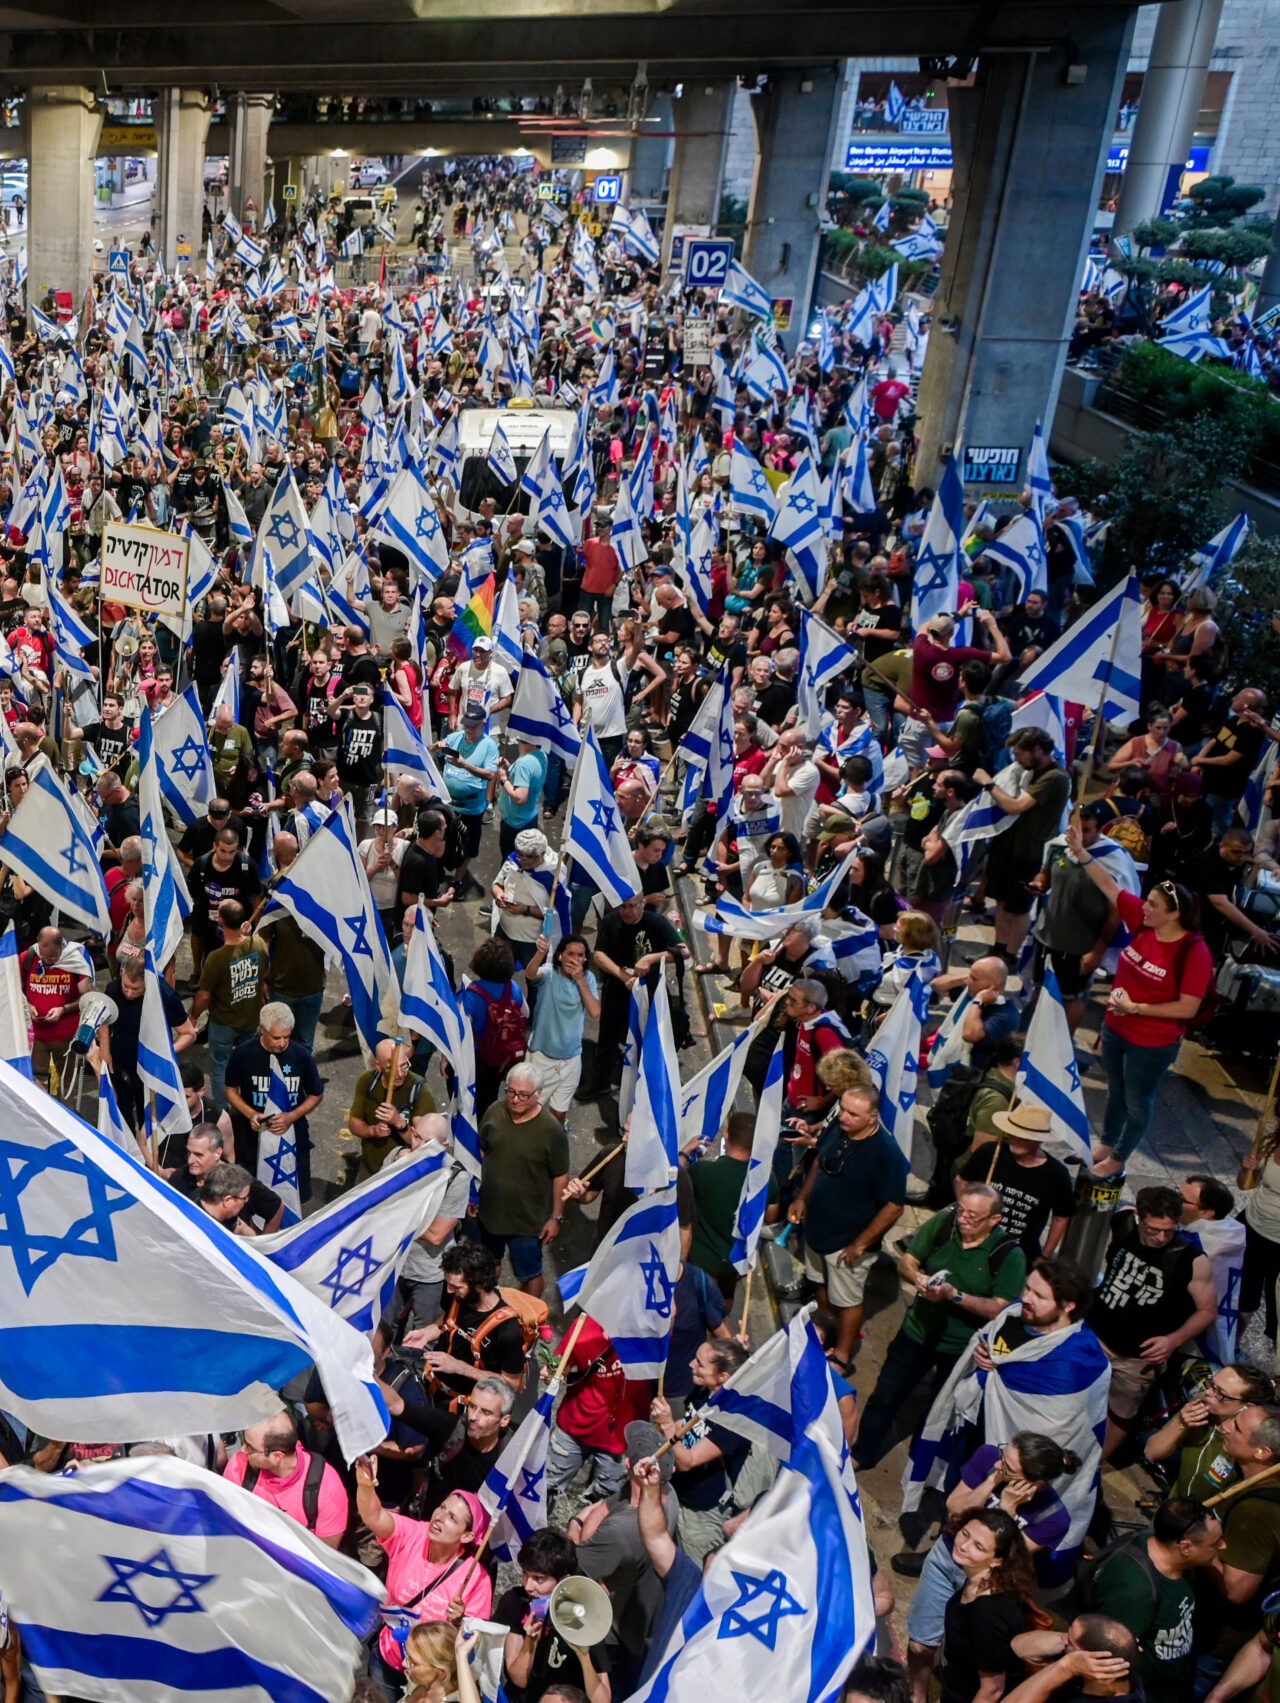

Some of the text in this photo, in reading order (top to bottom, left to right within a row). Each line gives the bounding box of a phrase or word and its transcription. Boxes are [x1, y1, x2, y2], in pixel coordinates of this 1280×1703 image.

[905, 111, 942, 121] חופשי
[931, 147, 952, 156] Statio
[598, 181, 617, 196] 01
[691, 250, 727, 278] 02
[967, 448, 1020, 464] חופשי
[965, 464, 1017, 481] בארצנו
[105, 566, 181, 602] DICKTATOR
